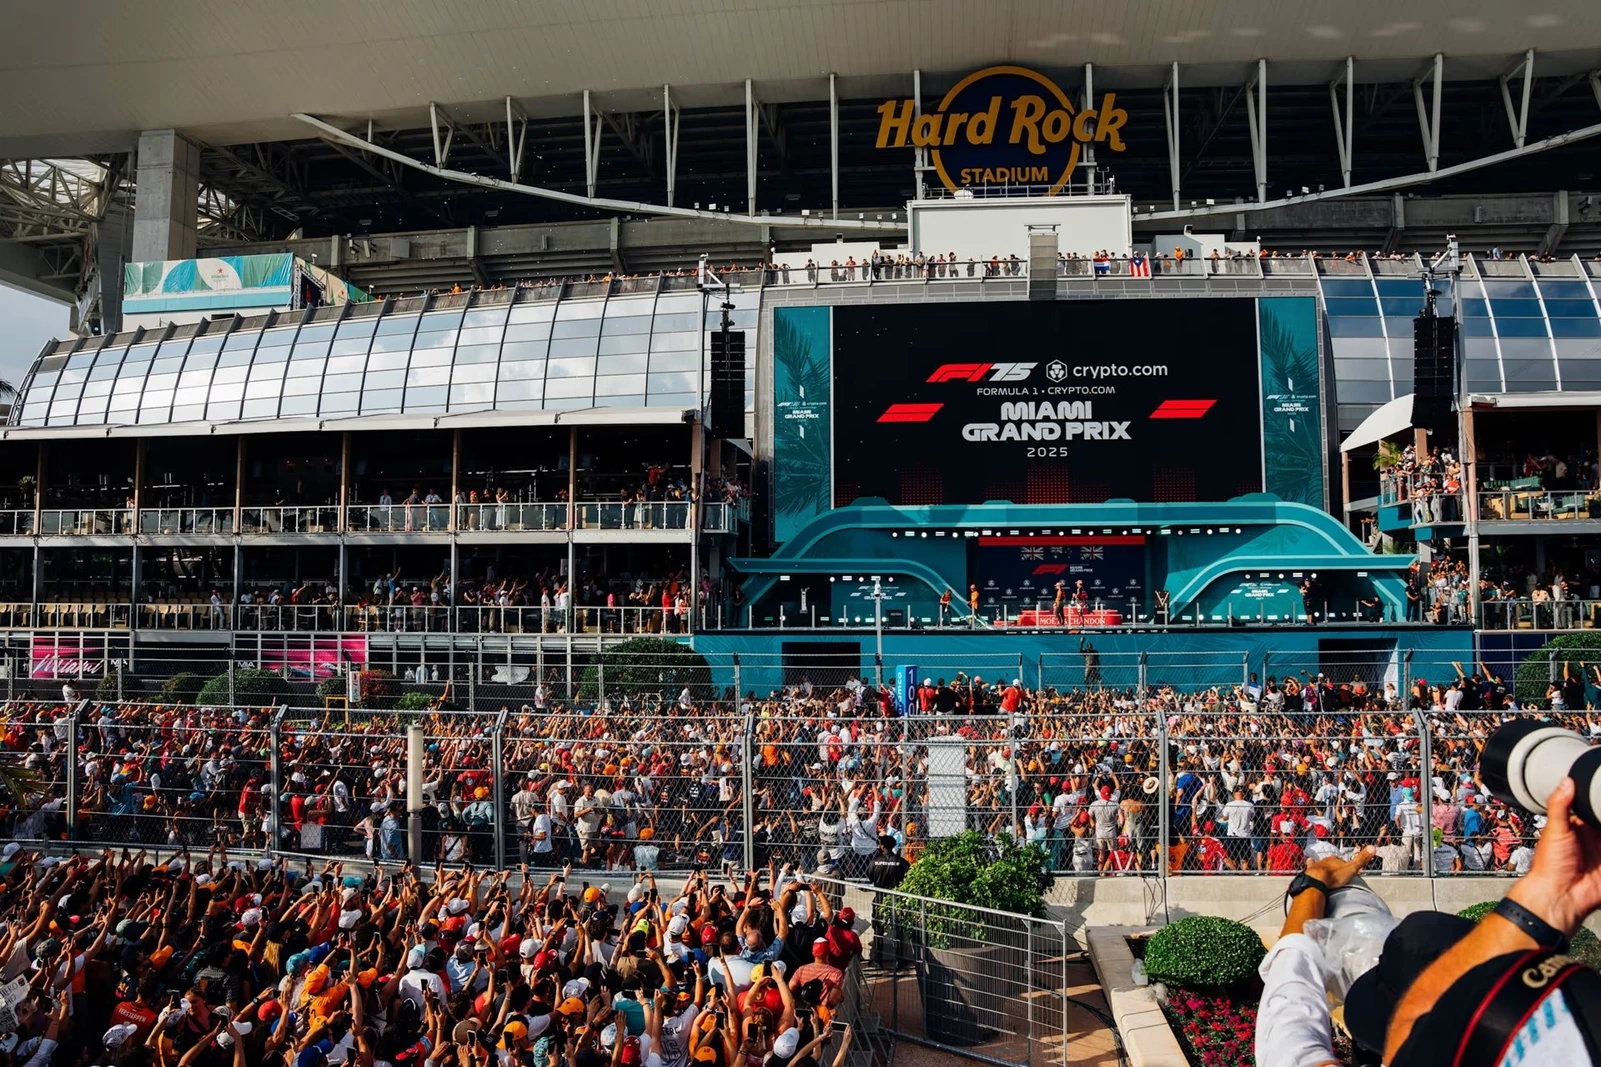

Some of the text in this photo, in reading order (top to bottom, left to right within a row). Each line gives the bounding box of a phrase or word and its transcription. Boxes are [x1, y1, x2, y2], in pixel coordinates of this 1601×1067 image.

[875, 93, 1129, 155] Hard Rock
[960, 166, 1049, 184] STADIUM
[1072, 363, 1168, 379] crypto.com
[976, 386, 1116, 396] FORMULA 1 CRYPTO.COM
[1000, 401, 1092, 420] MIAMI
[961, 421, 1133, 442] GRAND PRIX
[1026, 447, 1069, 458] 2025
[1040, 616, 1059, 625] MOË
[118, 1008, 147, 1022] VERSTAPPEN
